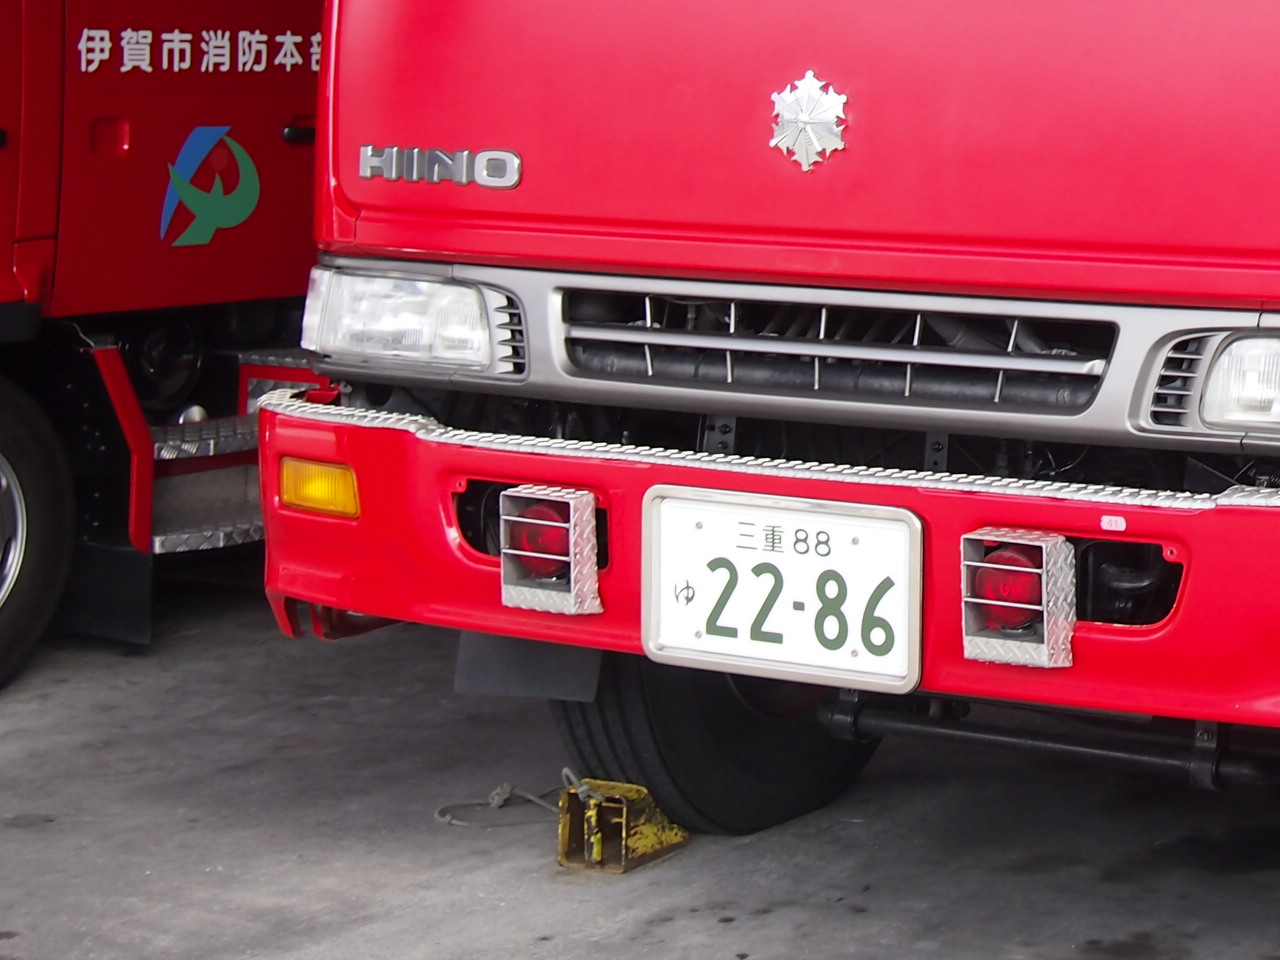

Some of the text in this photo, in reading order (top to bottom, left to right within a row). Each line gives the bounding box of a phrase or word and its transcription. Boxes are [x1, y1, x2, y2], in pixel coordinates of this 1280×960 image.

[359, 144, 522, 190] HINO
[674, 556, 895, 657] ゆ 22-86
